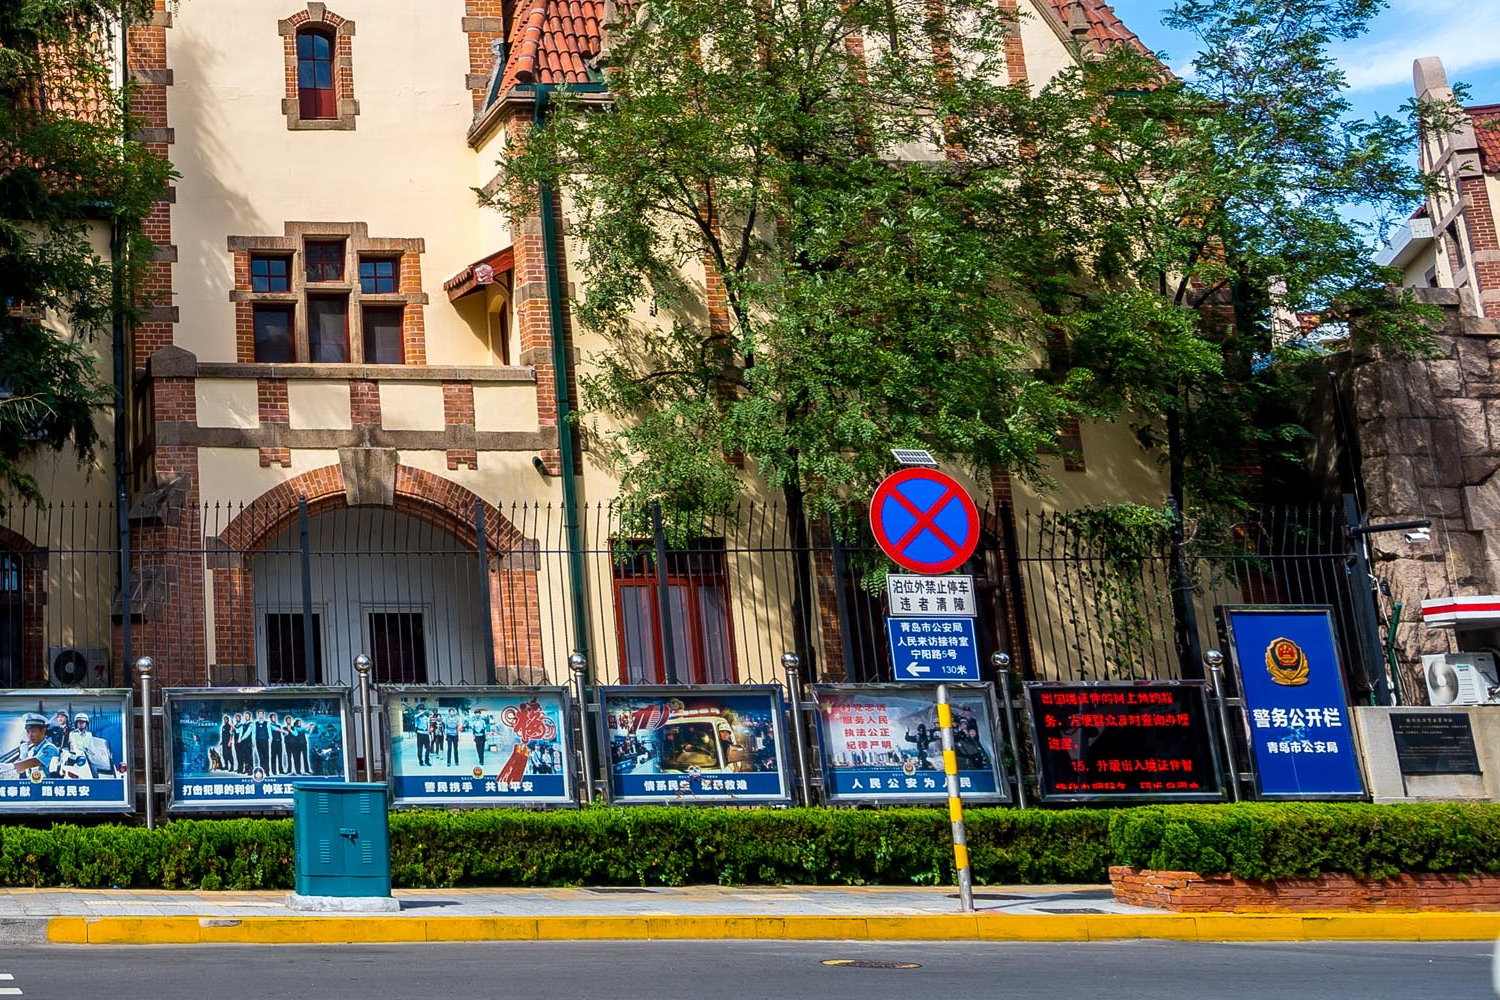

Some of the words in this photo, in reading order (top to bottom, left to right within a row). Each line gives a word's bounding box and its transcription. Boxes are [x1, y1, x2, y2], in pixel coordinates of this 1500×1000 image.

[892, 579, 969, 595] 泊位外禁止停车
[900, 597, 965, 612] 违者清障
[900, 622, 963, 633] 青岛市公安局
[897, 636, 969, 647] 人民来访接待室
[910, 649, 957, 660] 宁阳路5号
[941, 665, 967, 675] 130米
[842, 715, 889, 725] 服务人民
[1252, 707, 1342, 729] 警务公开栏
[844, 727, 891, 738] 执法公正
[846, 740, 893, 750] 纪律严明
[1266, 740, 1339, 754] 青岛市公安局
[41, 785, 90, 797] 路畅民安
[182, 783, 256, 796] 打击犯罪的利剑
